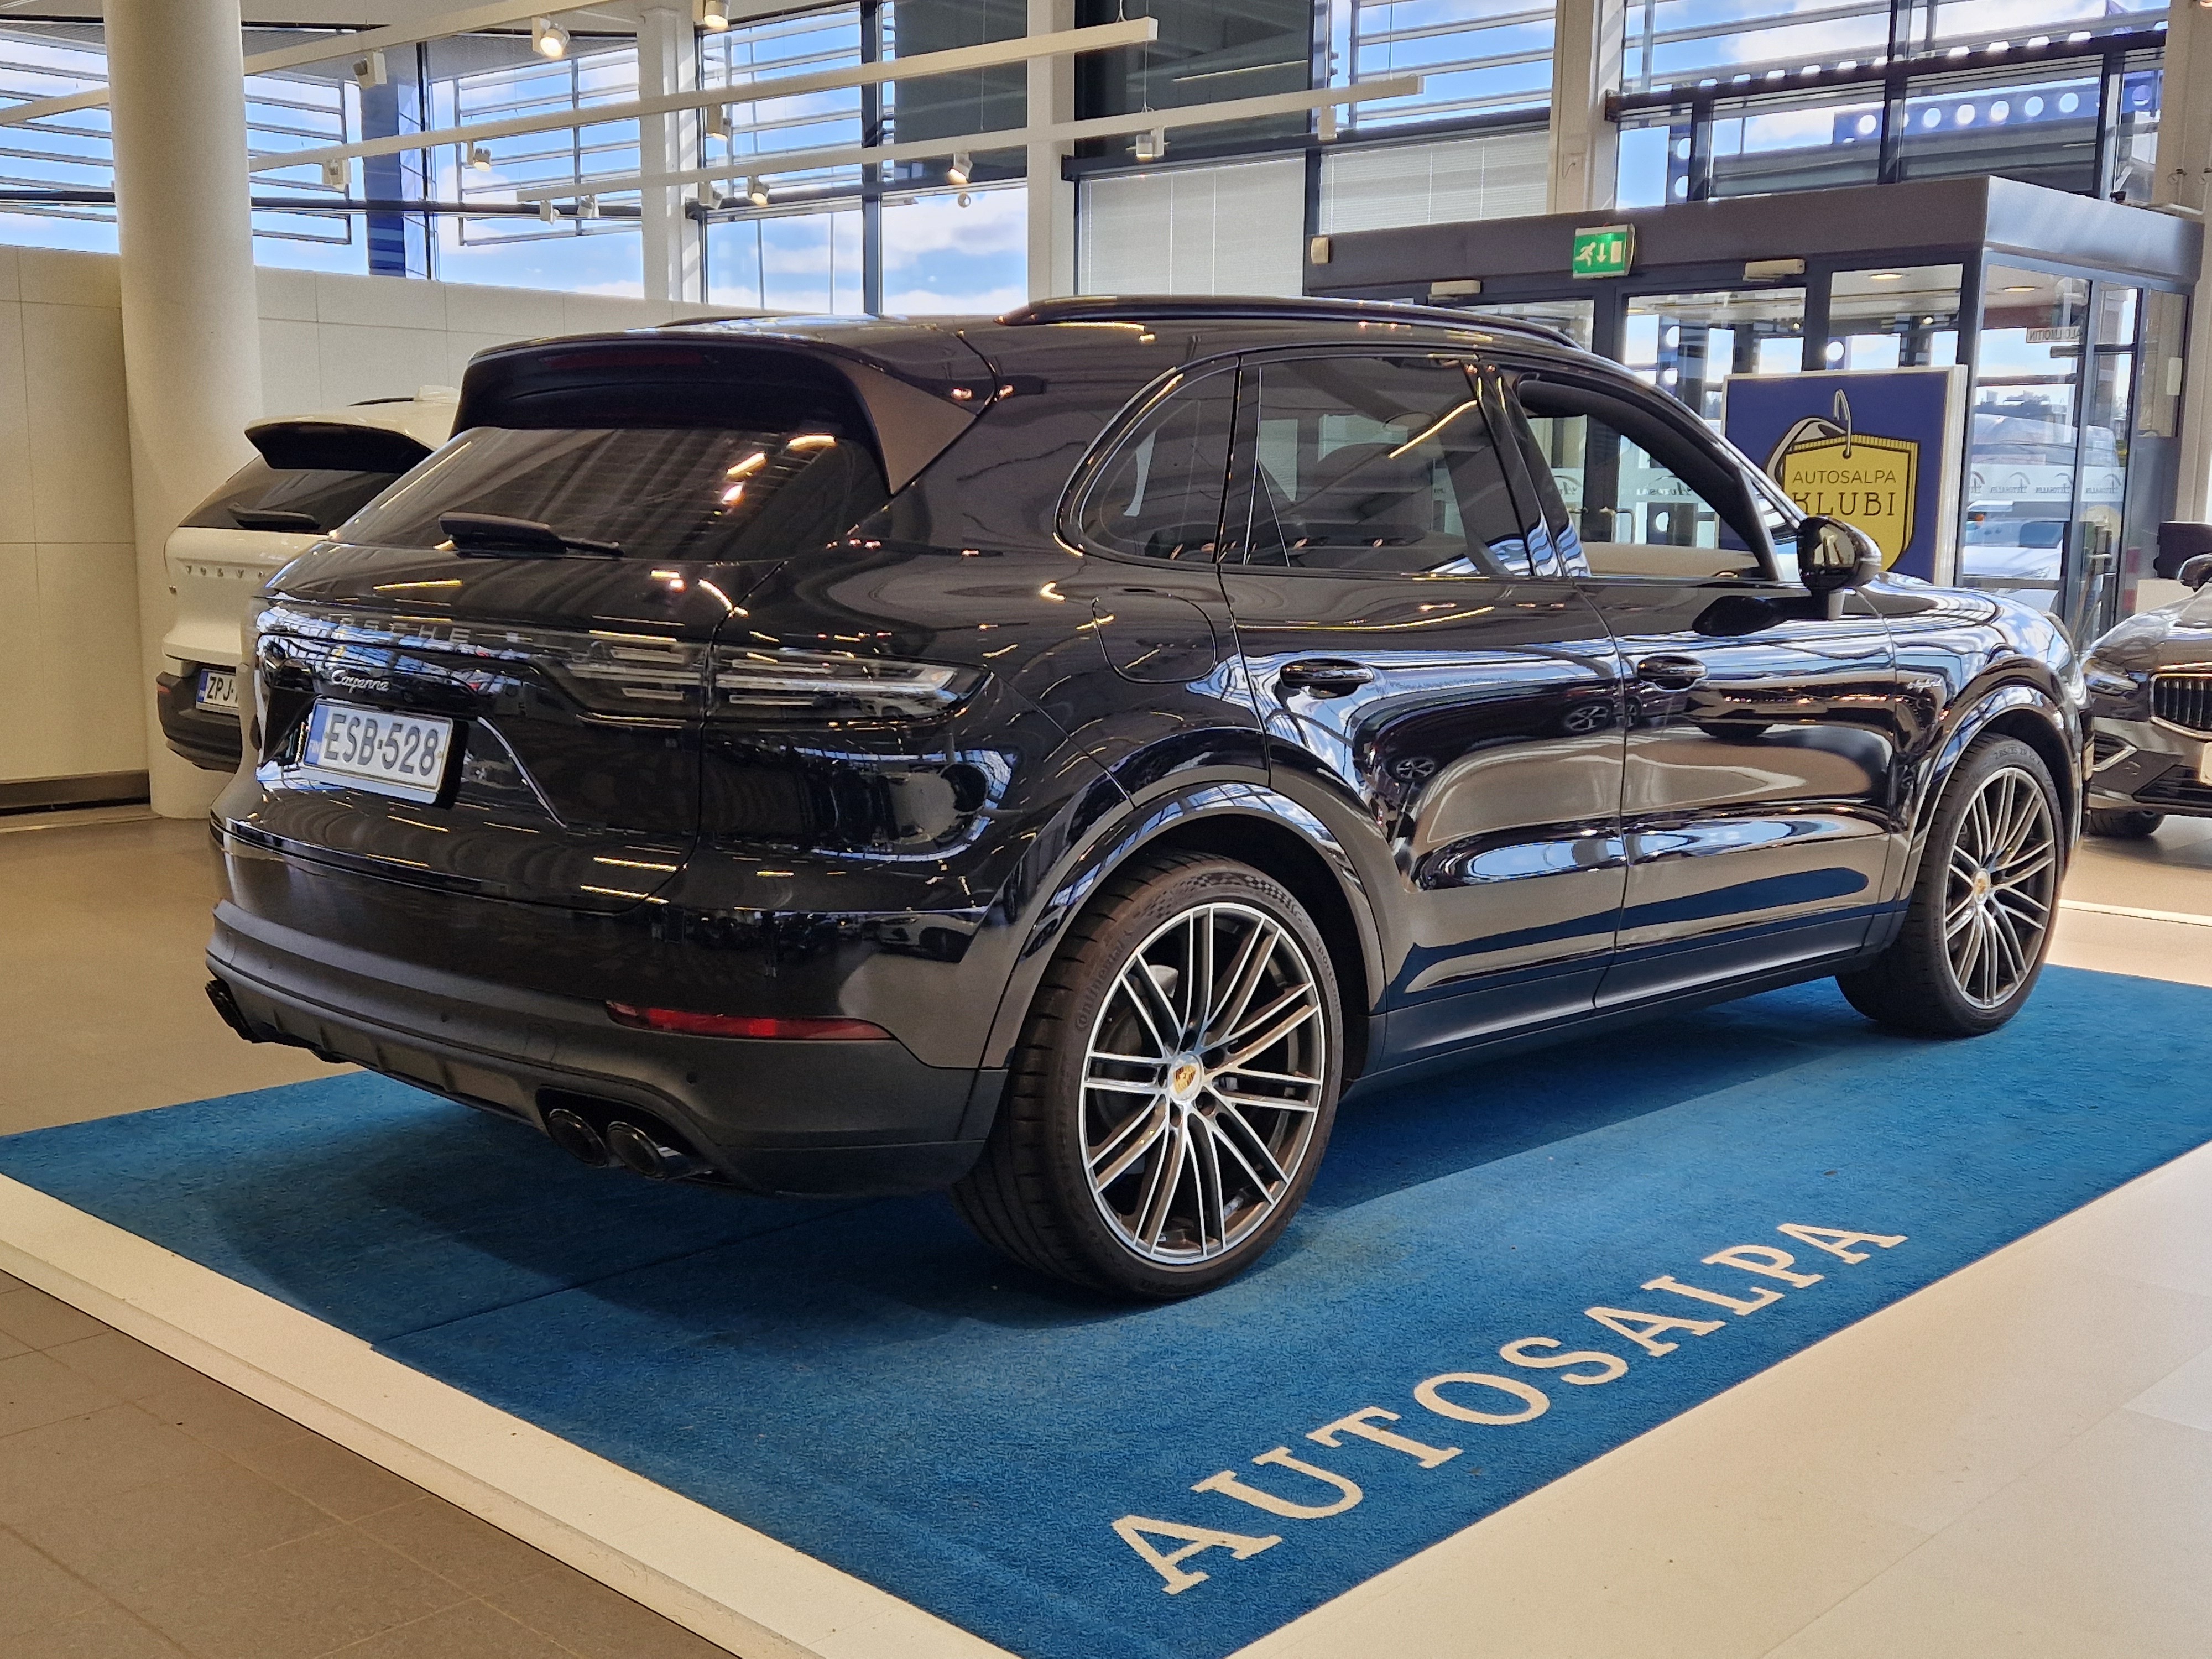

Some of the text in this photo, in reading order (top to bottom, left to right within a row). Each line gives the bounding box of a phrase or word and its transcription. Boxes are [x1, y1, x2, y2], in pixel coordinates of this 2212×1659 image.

[1792, 470, 1897, 484] AUTOSALPA
[1792, 492, 1896, 516] KLUBI
[331, 670, 389, 693] Cayenne
[324, 713, 439, 776] ESB-528
[1110, 1223, 1908, 1595] AUTOSALPA
